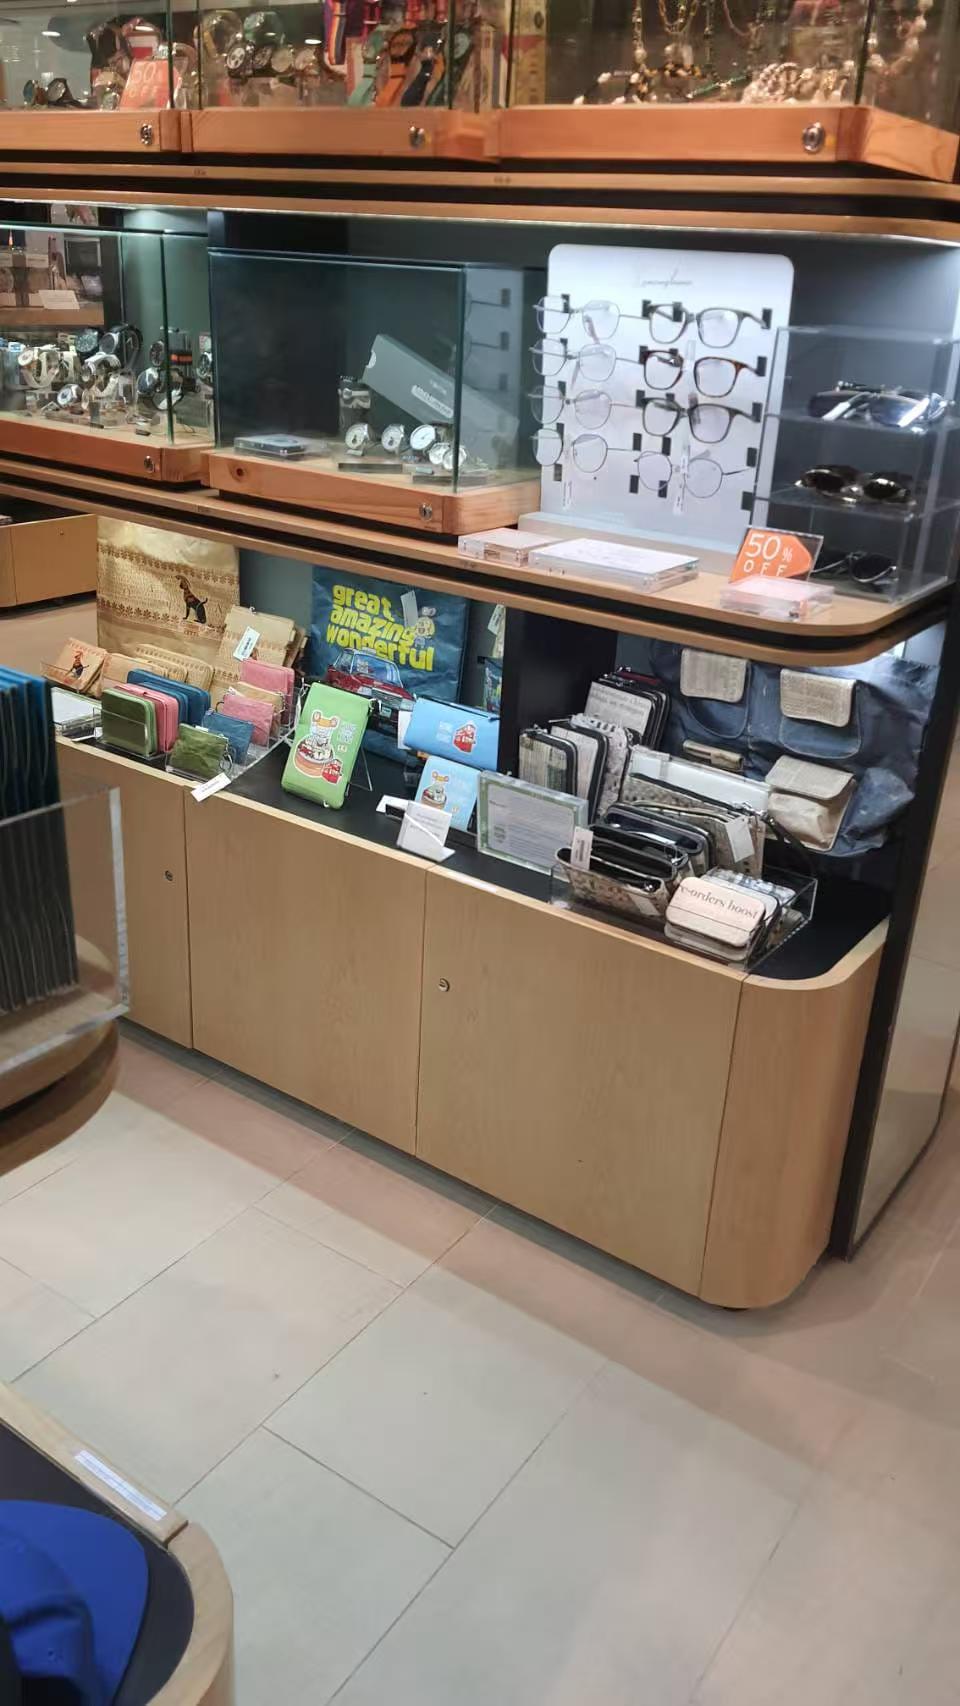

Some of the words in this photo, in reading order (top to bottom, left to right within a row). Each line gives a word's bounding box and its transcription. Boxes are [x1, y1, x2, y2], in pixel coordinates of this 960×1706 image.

[744, 533, 793, 562] 50%
[743, 559, 788, 577] OFF
[332, 584, 395, 622] great
[330, 603, 416, 646] amazing
[326, 623, 435, 671] wonderful
[728, 899, 759, 919] boost
